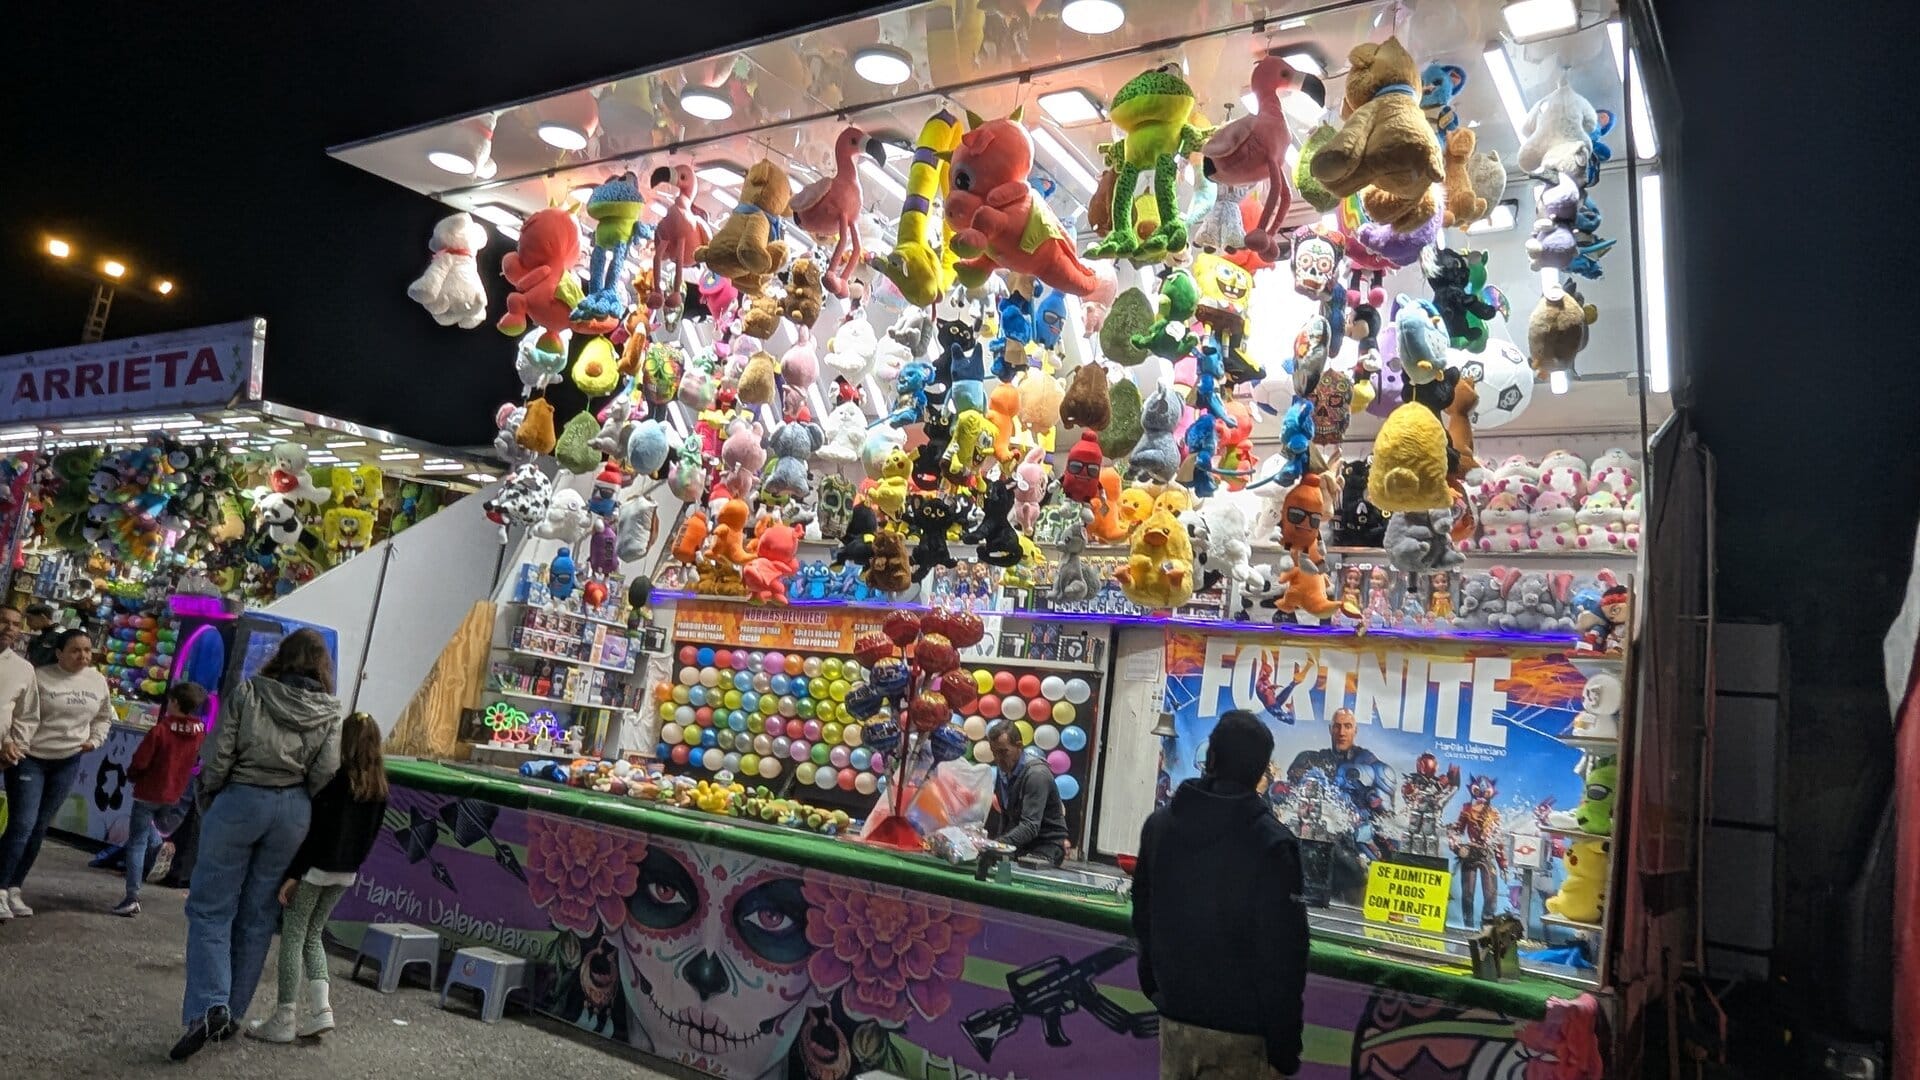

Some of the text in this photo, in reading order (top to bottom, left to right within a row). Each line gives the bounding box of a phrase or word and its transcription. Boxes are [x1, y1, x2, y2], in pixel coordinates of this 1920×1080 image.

[12, 347, 224, 404] ARRIETA
[744, 607, 827, 625] NORMAS DEL JUEGO
[1198, 636, 1512, 747] FORTNITE
[1377, 866, 1442, 886] SE ADMITEN
[1388, 883, 1426, 899] PAGOS
[1368, 895, 1391, 909] CON
[1393, 900, 1441, 918] TARJETA
